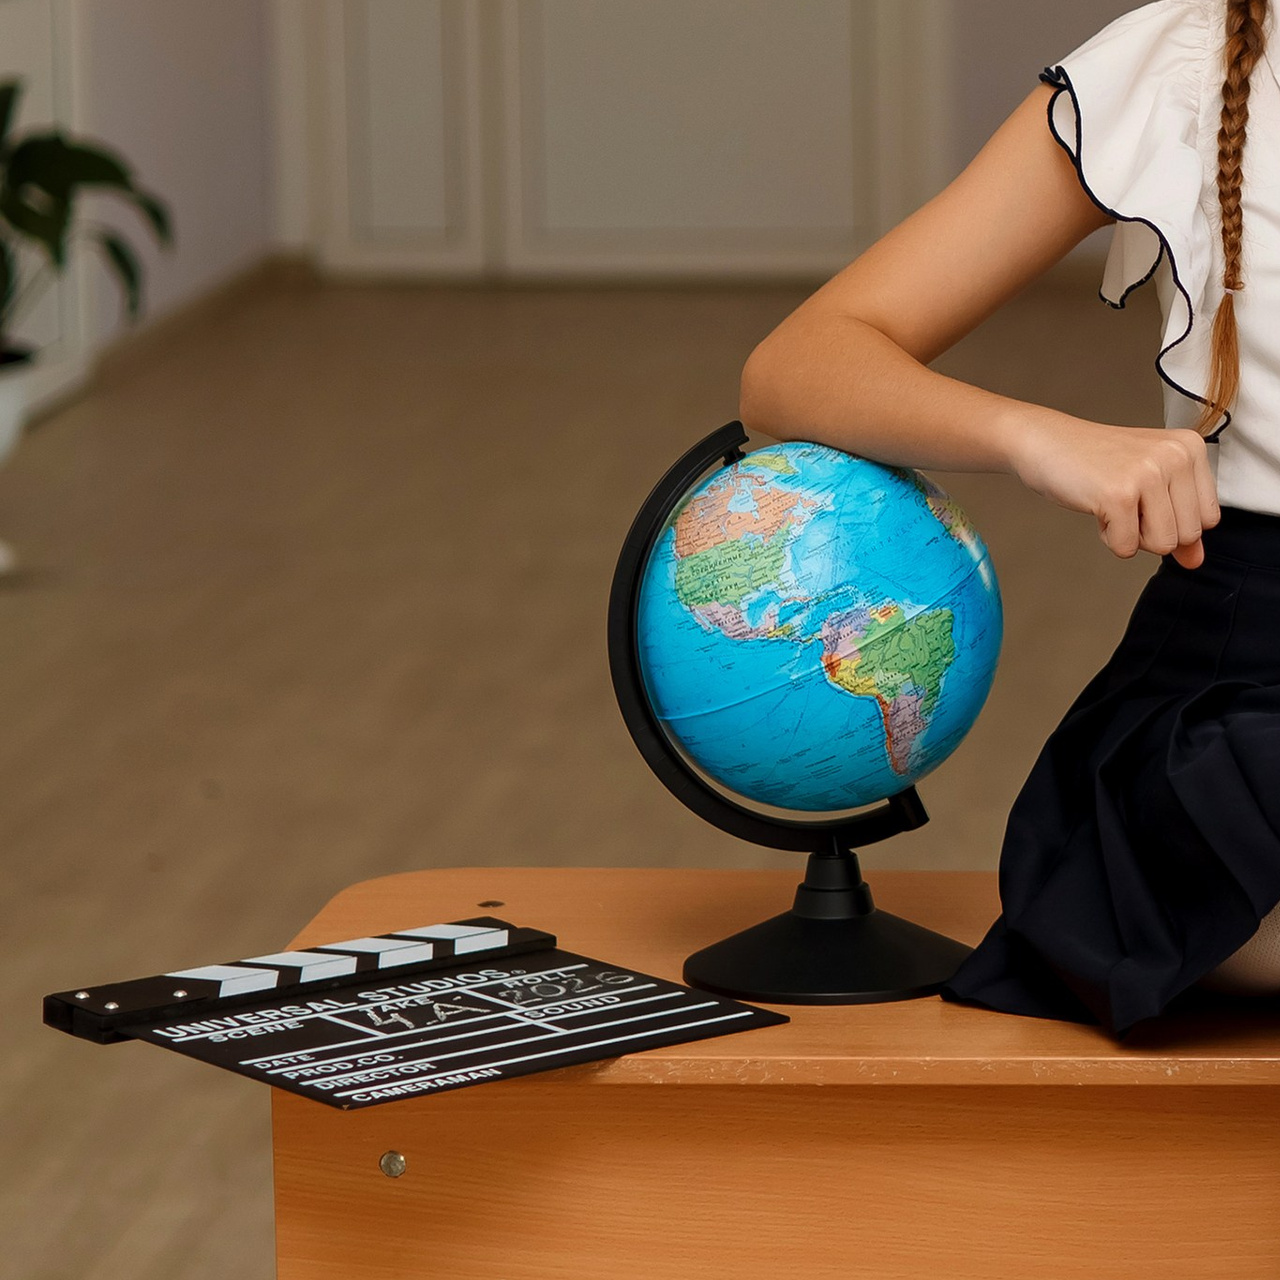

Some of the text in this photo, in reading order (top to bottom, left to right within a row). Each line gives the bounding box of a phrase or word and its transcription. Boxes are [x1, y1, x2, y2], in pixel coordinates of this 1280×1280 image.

[502, 969, 576, 989] ROLL
[359, 996, 435, 1014] TAKE
[524, 995, 621, 1020] SOUND
[152, 998, 358, 1039] UNIVERSAL
[208, 1020, 304, 1043] SCENE
[253, 1054, 316, 1070] DATE
[313, 1061, 437, 1090] DIRECTOR
[351, 1067, 502, 1103] CAMERAMAN
